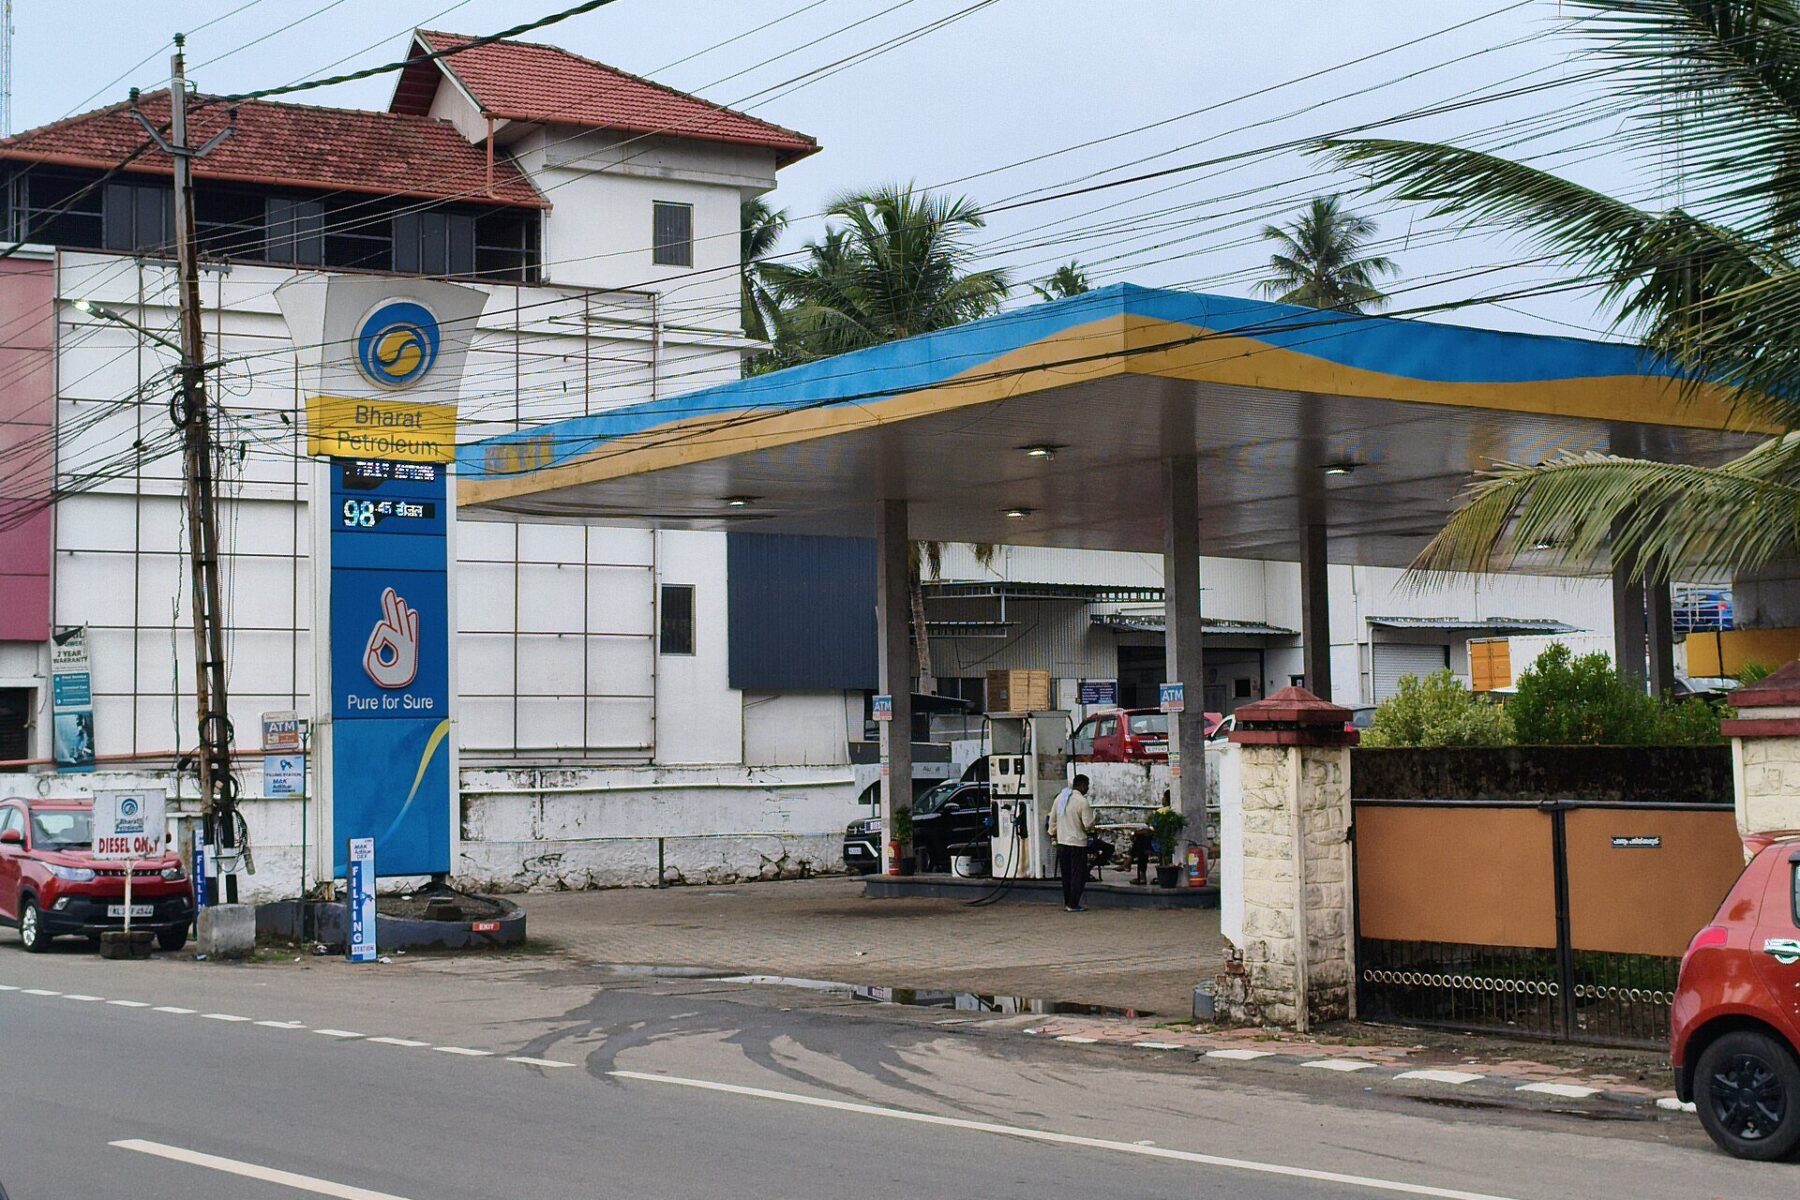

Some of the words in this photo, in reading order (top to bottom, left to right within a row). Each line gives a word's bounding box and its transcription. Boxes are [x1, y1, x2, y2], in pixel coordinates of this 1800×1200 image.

[355, 404, 422, 428] Bharat
[337, 431, 438, 456] Petroleum
[53, 656, 88, 664] WARRANTY
[347, 694, 379, 710] Pure
[382, 694, 400, 710] for
[403, 694, 434, 710] Sure
[1162, 689, 1184, 702] ATM
[873, 701, 893, 712] ATM
[268, 721, 296, 733] ATM
[98, 837, 130, 853] DIESEL
